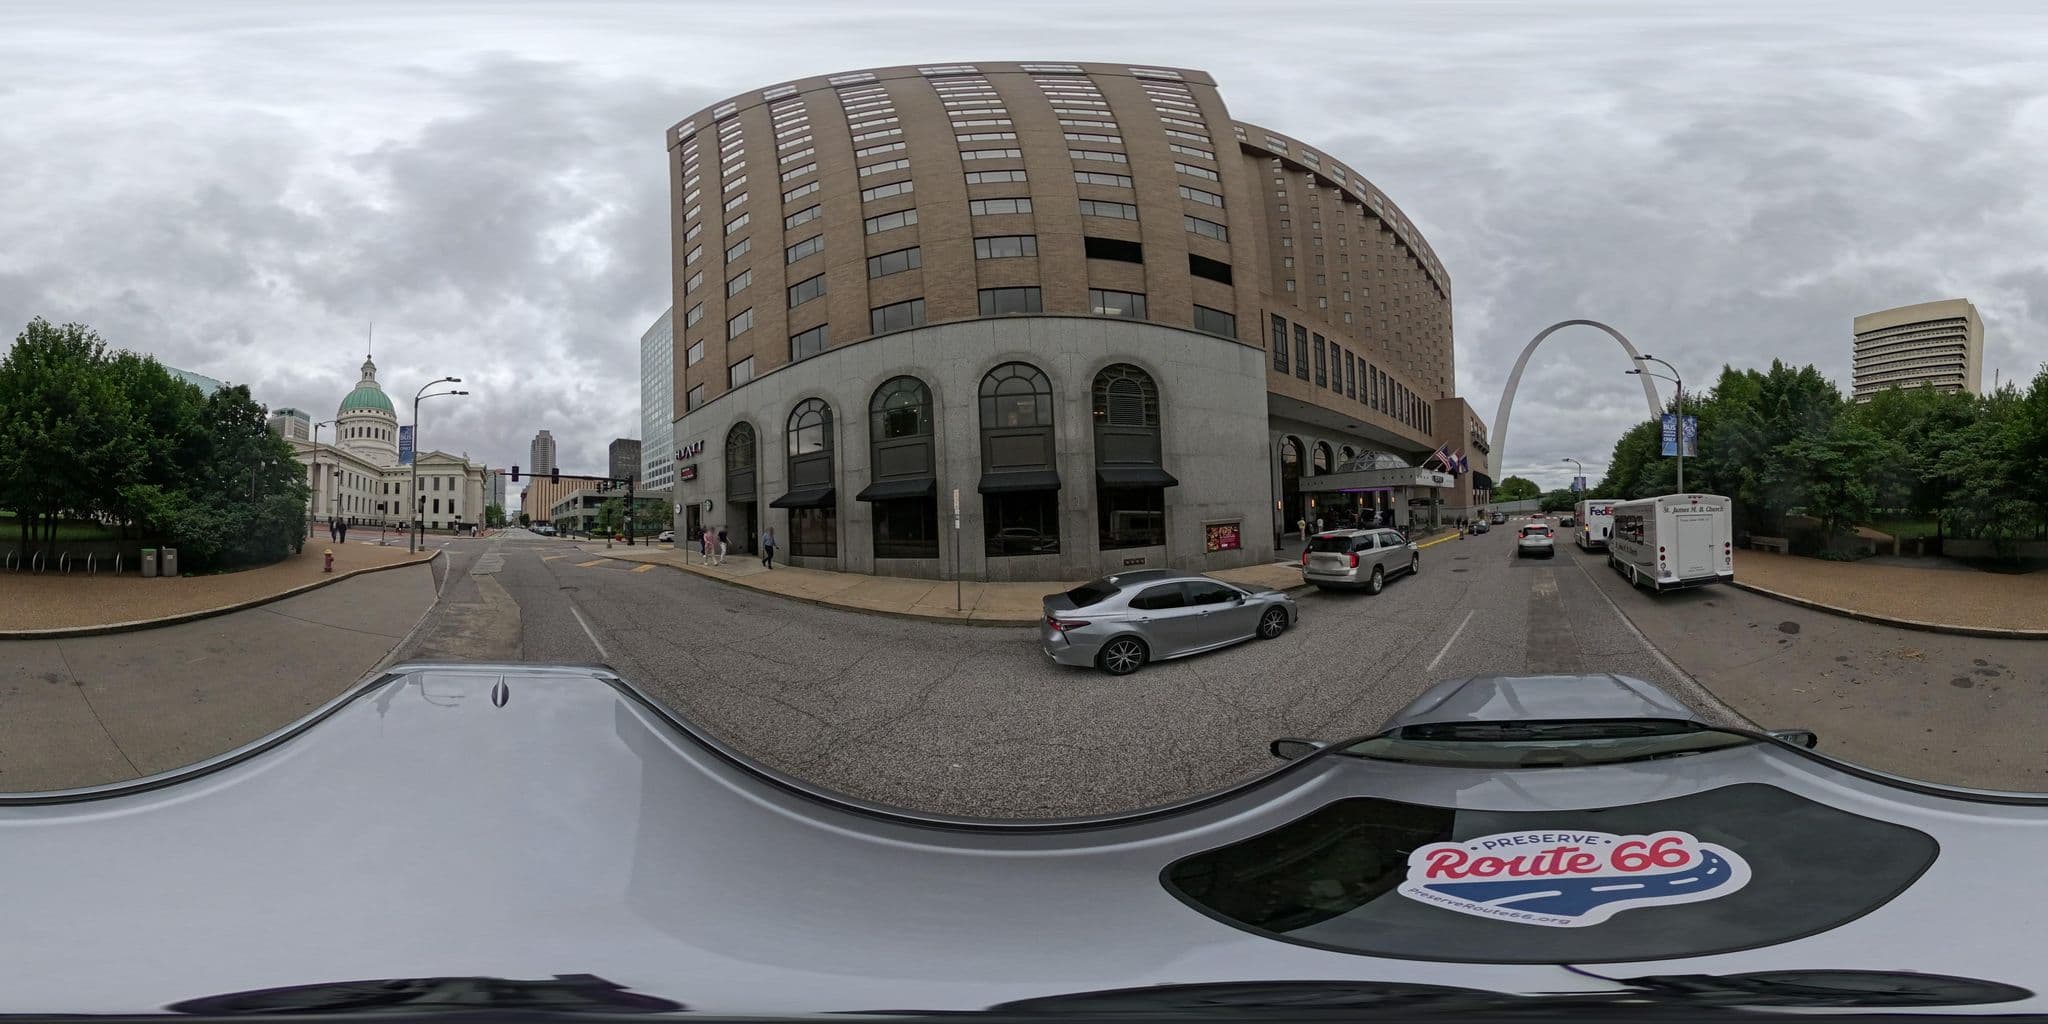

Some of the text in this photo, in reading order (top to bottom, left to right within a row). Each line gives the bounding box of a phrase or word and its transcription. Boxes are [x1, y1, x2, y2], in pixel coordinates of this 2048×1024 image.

[675, 440, 705, 460] HYATT
[1590, 506, 1614, 516] FedE
[1672, 506, 1689, 514] James
[1484, 833, 1600, 850] PRESERVE
[1425, 837, 1690, 879] Route 66
[1407, 887, 1571, 925] PreserveRoute66.org
